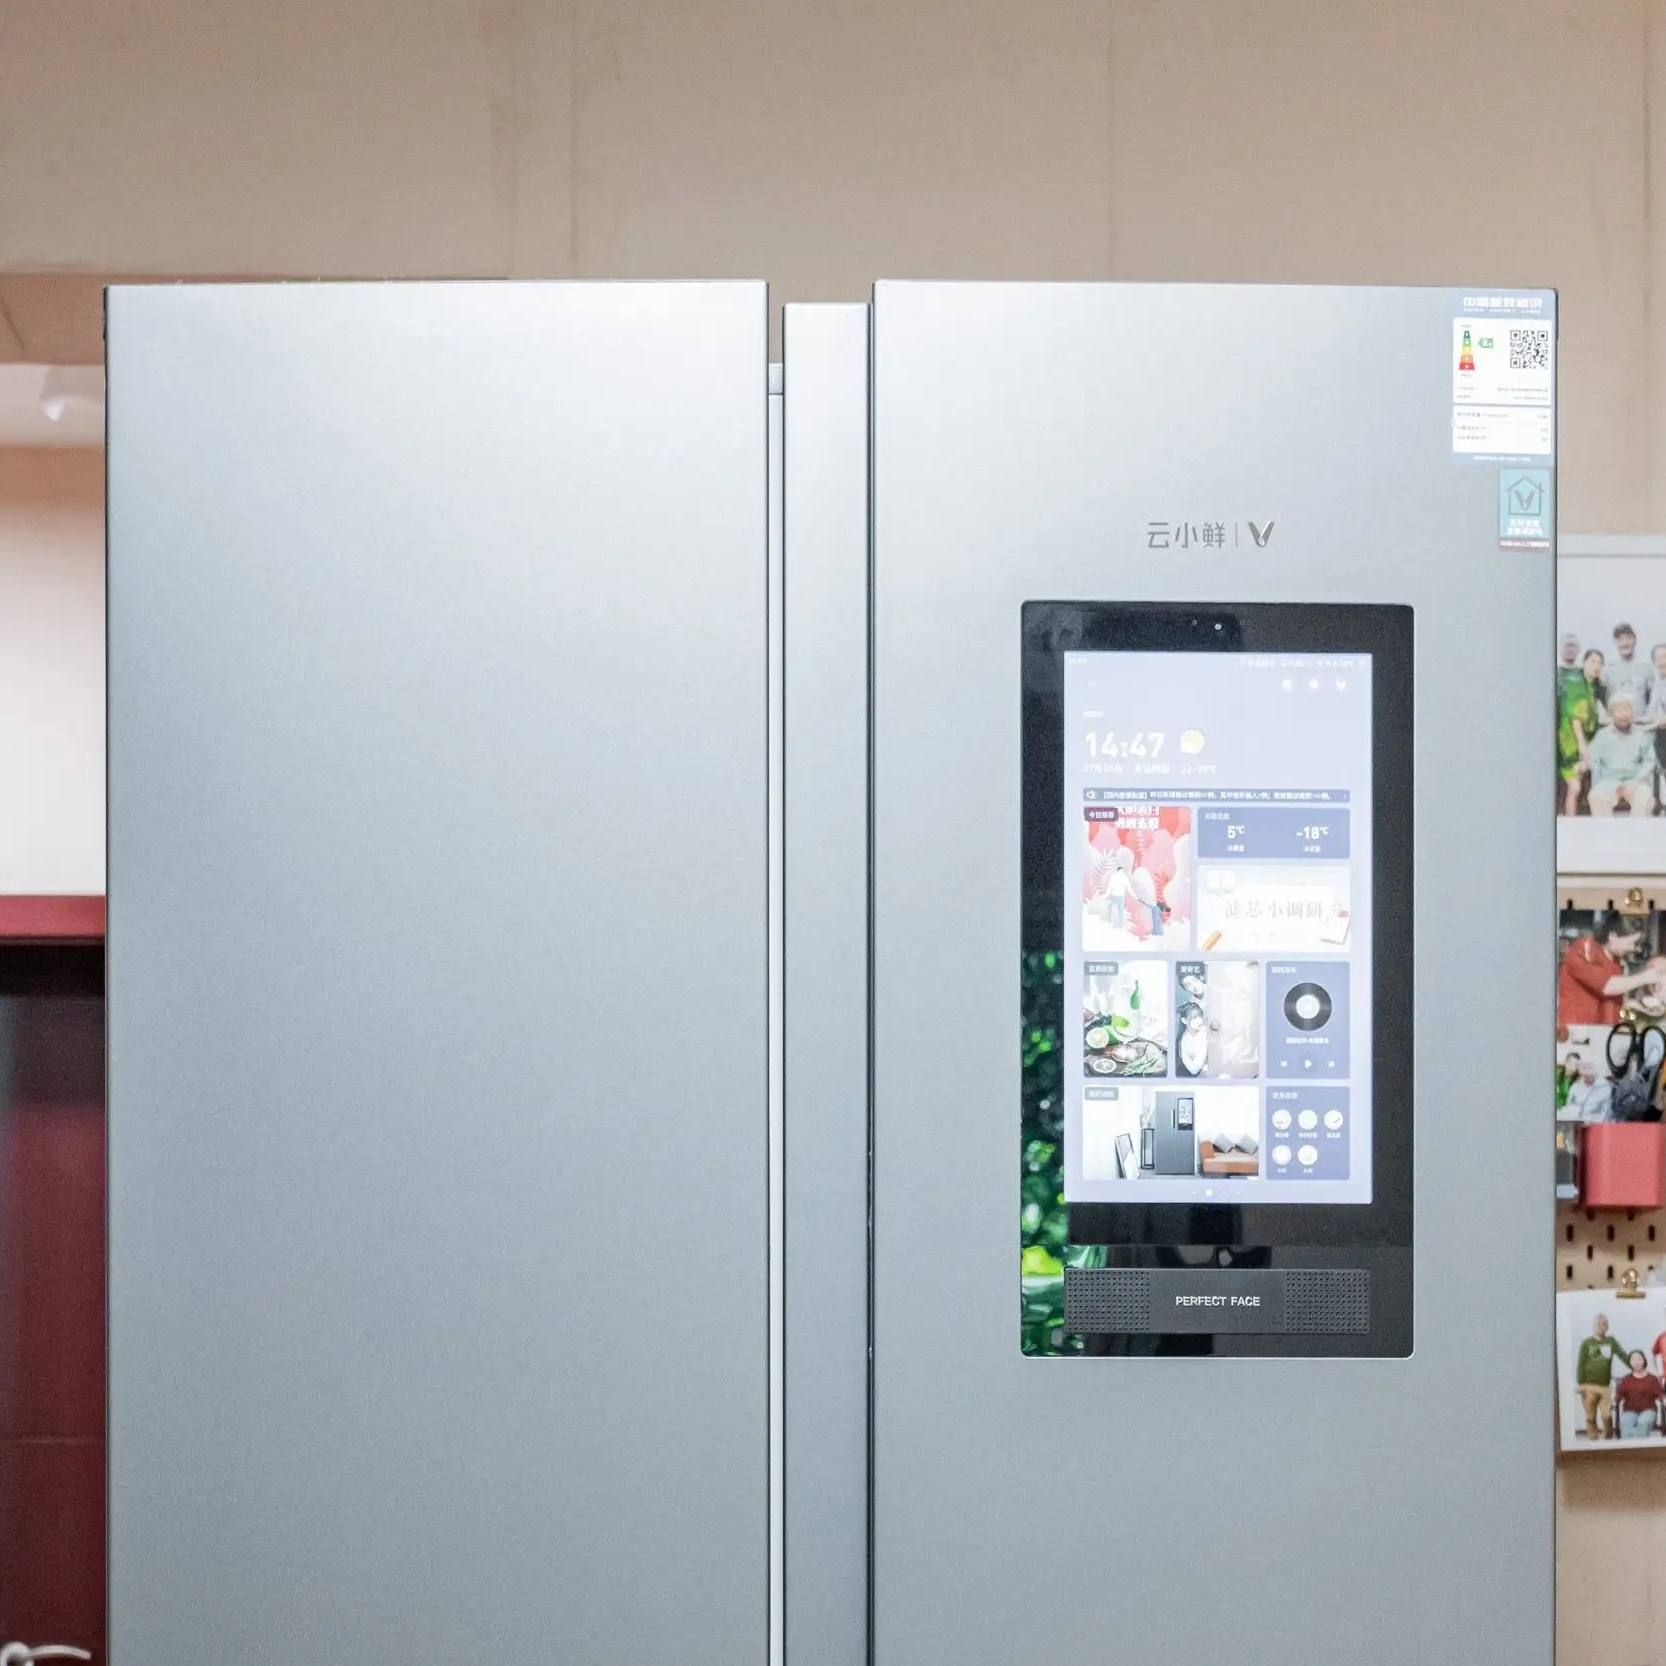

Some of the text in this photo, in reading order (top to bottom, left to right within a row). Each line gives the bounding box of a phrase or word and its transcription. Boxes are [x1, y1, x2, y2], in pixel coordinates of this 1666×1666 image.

[1147, 520, 1226, 549] 云小鲜
[1084, 730, 1166, 759] 14:47
[1175, 1295, 1261, 1308] PERFECT FACE
